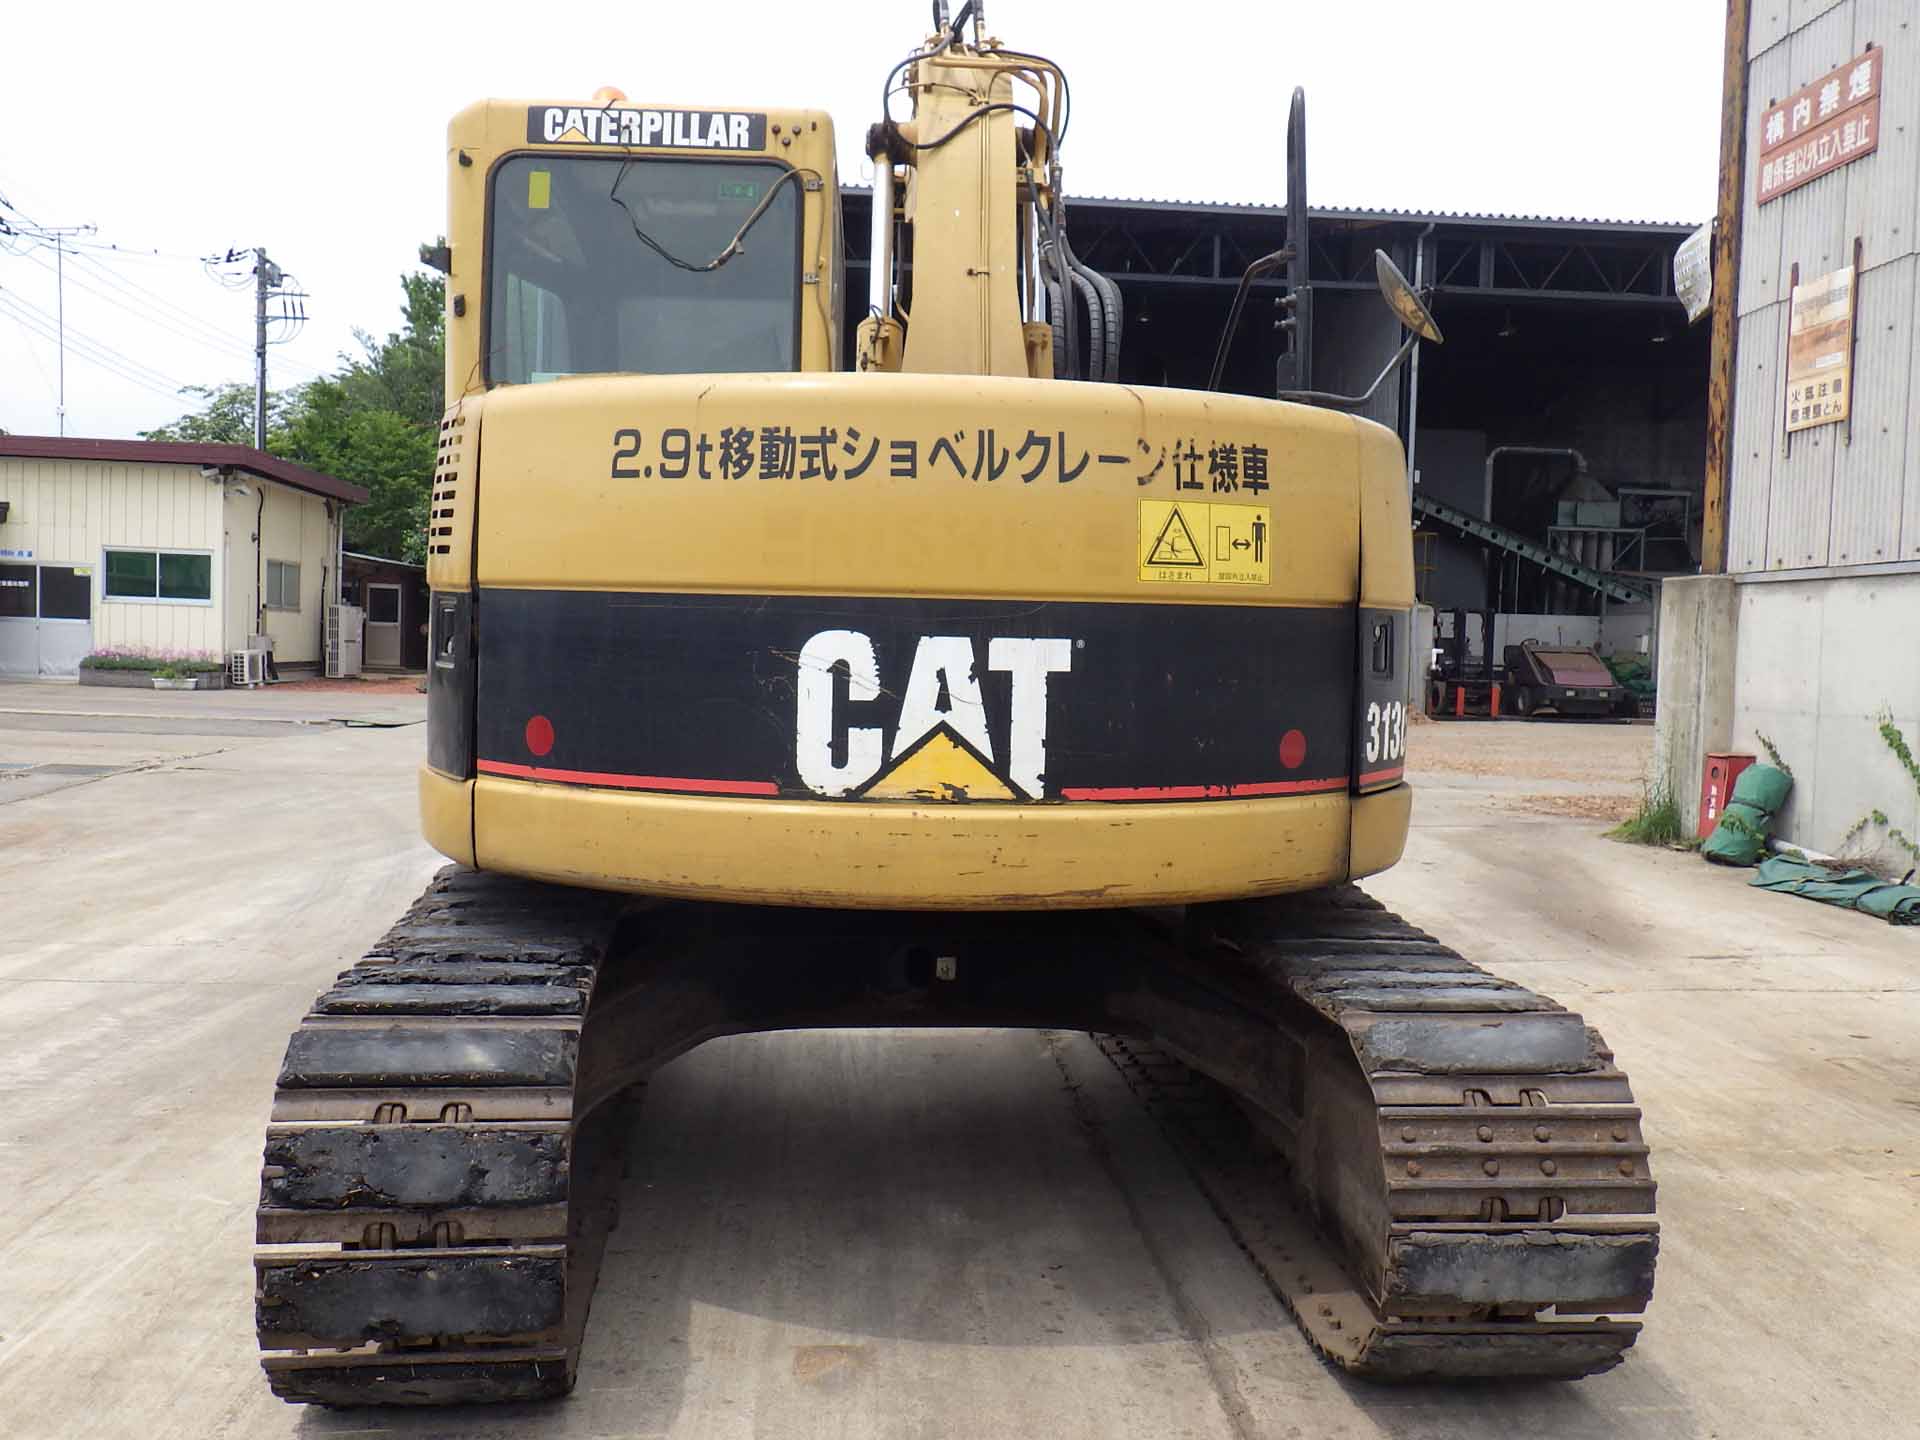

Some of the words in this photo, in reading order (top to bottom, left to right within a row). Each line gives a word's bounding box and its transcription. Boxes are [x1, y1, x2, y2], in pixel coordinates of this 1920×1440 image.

[543, 107, 750, 148] CATERPILLAR
[611, 426, 1270, 495] 2.9t移動式ショベルクレーン仕様車
[796, 629, 1072, 800] CAT
